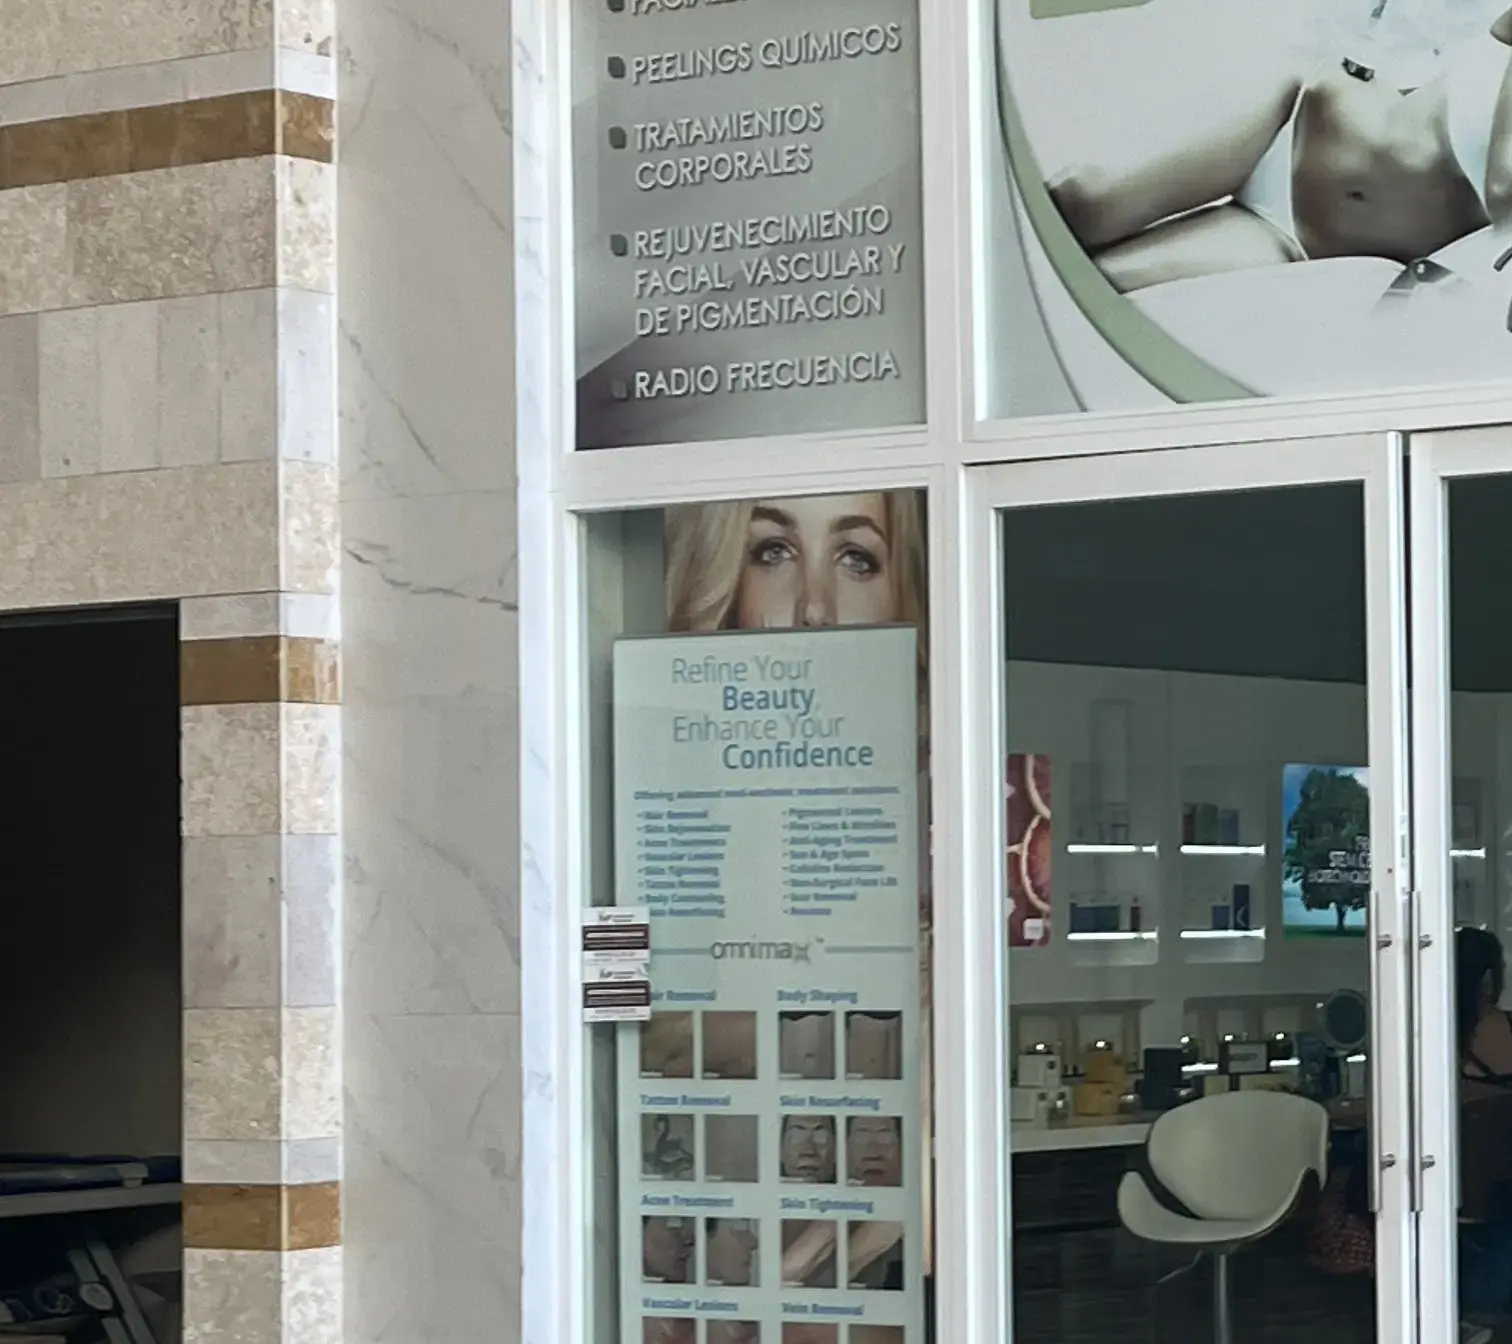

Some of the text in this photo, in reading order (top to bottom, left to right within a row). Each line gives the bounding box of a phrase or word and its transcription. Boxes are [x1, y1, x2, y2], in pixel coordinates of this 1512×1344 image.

[632, 22, 901, 85] PEELINGS QUÍMICOS
[634, 102, 823, 151] TRATAMIENTOS
[635, 143, 812, 190] CORPORALES
[635, 204, 891, 259] REJUVENECIMIENTO
[635, 243, 904, 299] FACIAL, VASCULAR Y
[635, 285, 885, 338] DE PIGMENTACIÓN
[635, 349, 900, 399] RADIO FRECUENCIA
[671, 655, 813, 684] Refine Your
[673, 713, 845, 743] Enhance Your
[722, 741, 873, 769] Confidence
